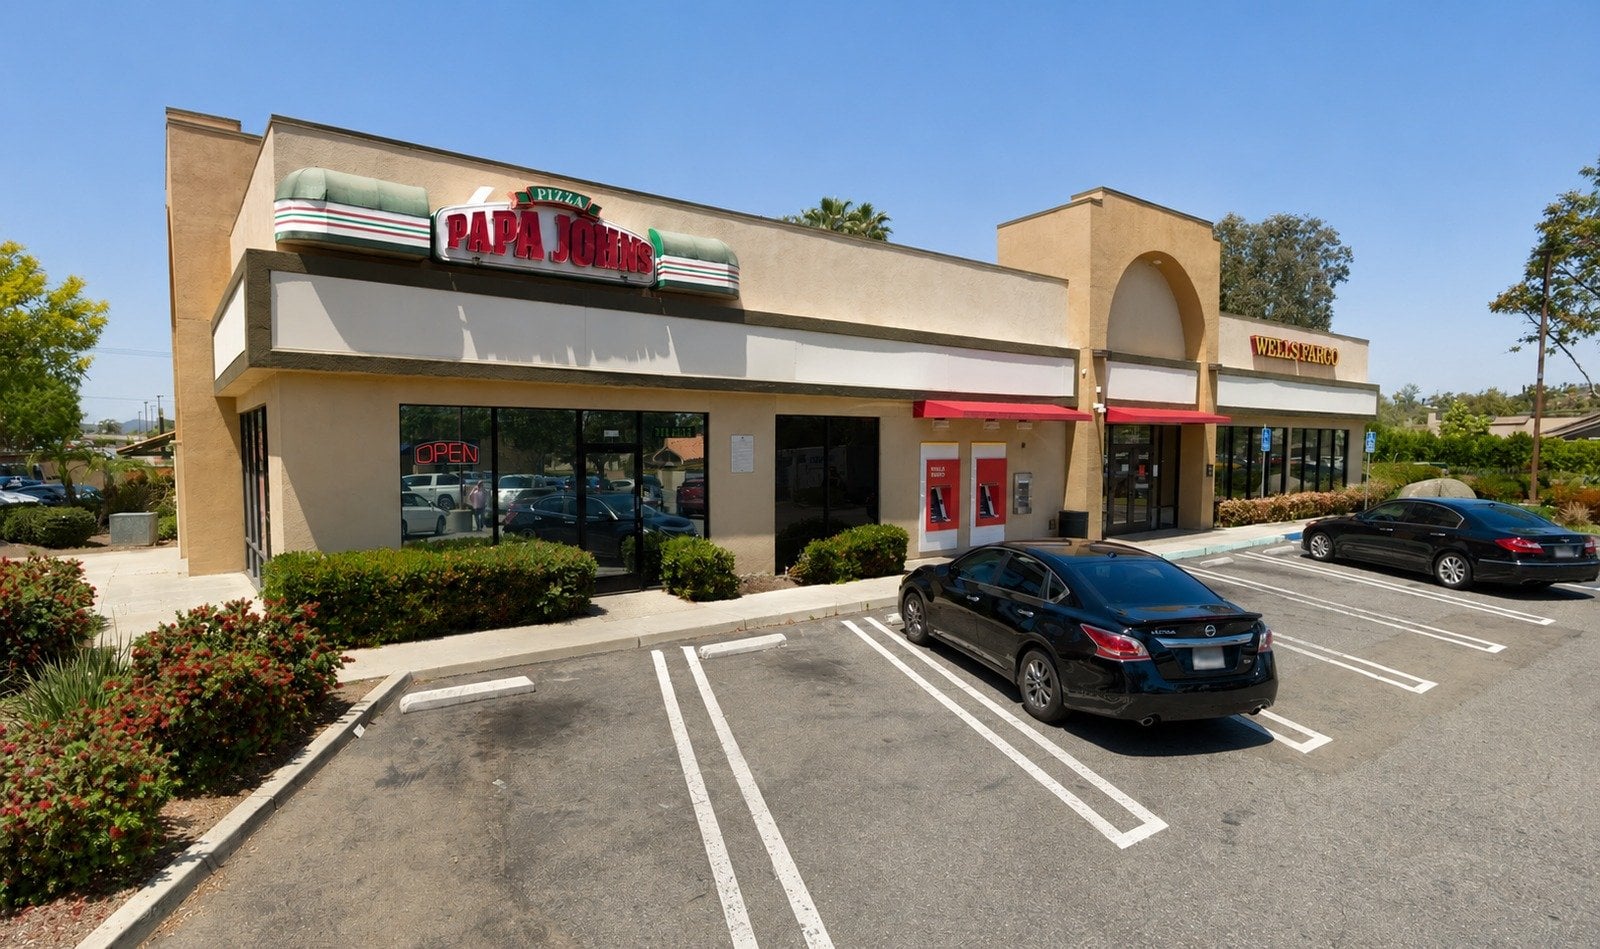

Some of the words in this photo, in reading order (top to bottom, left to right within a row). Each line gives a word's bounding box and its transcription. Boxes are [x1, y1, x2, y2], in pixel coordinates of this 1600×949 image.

[537, 188, 584, 208] PIZZA
[447, 210, 545, 261] PAPA
[551, 213, 653, 275] JOHNS
[1253, 336, 1299, 361] WELLS
[1300, 343, 1339, 366] FARGO
[416, 442, 478, 464] OPEN
